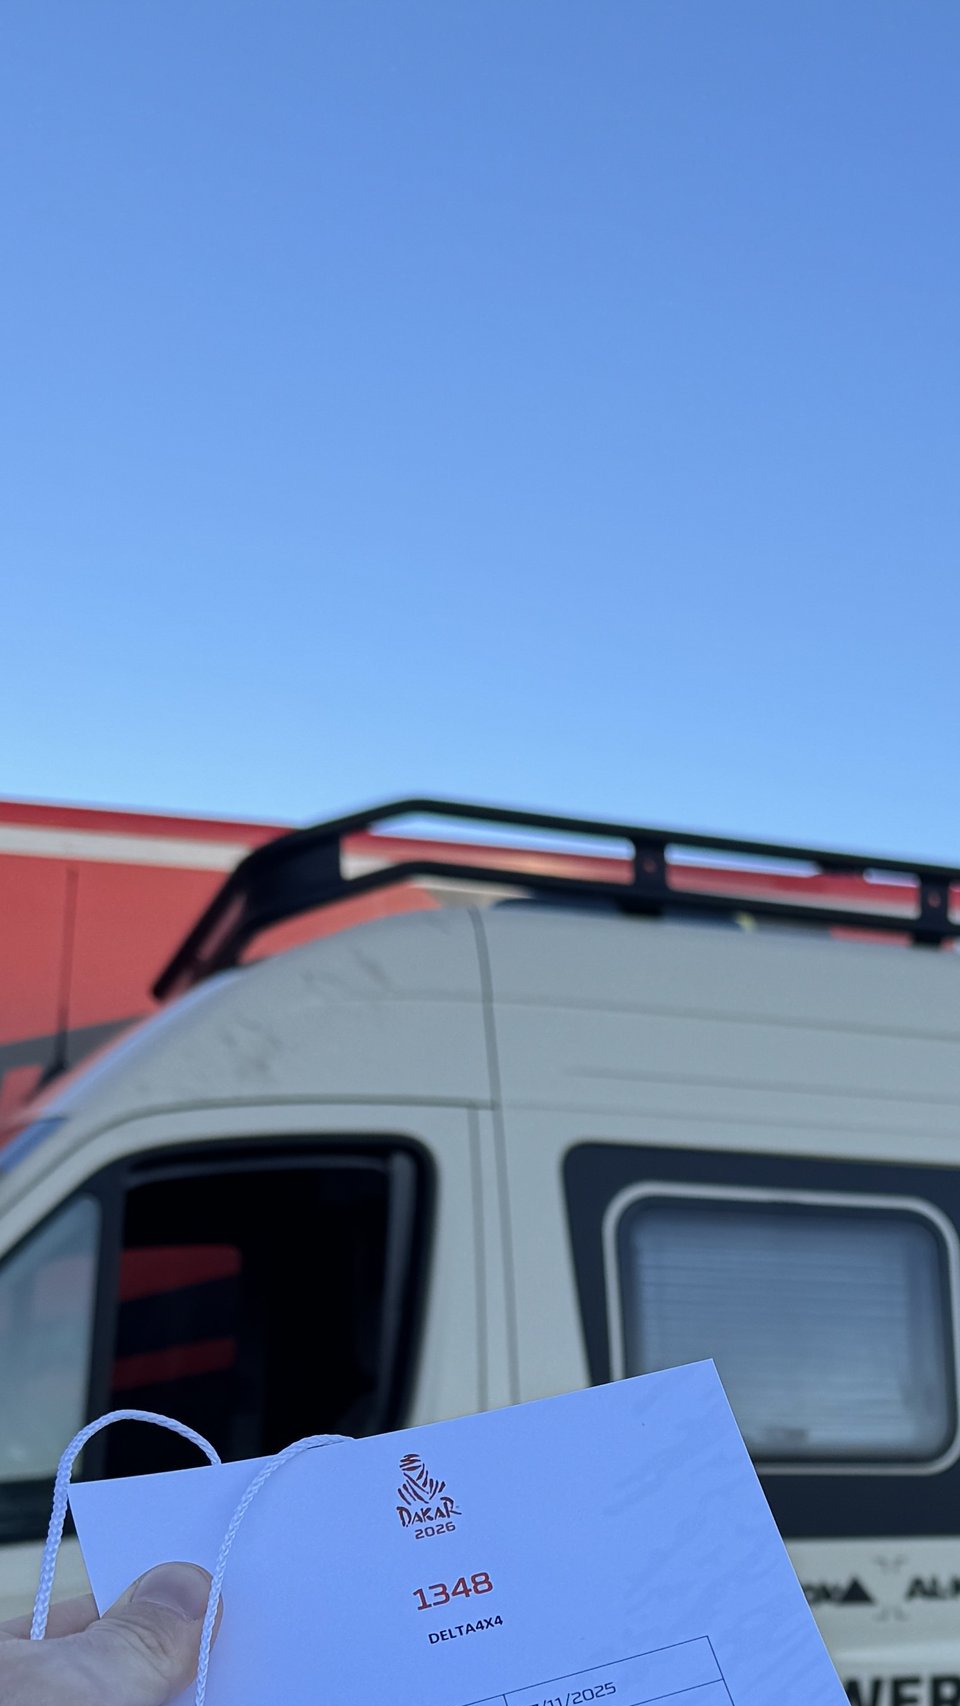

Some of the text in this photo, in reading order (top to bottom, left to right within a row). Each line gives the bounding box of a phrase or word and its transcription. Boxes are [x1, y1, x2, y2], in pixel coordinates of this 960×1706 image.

[396, 1496, 462, 1527] DAKAR
[415, 1521, 456, 1540] 2026
[412, 1572, 494, 1611] 1348
[428, 1615, 504, 1644] DELTA4X4
